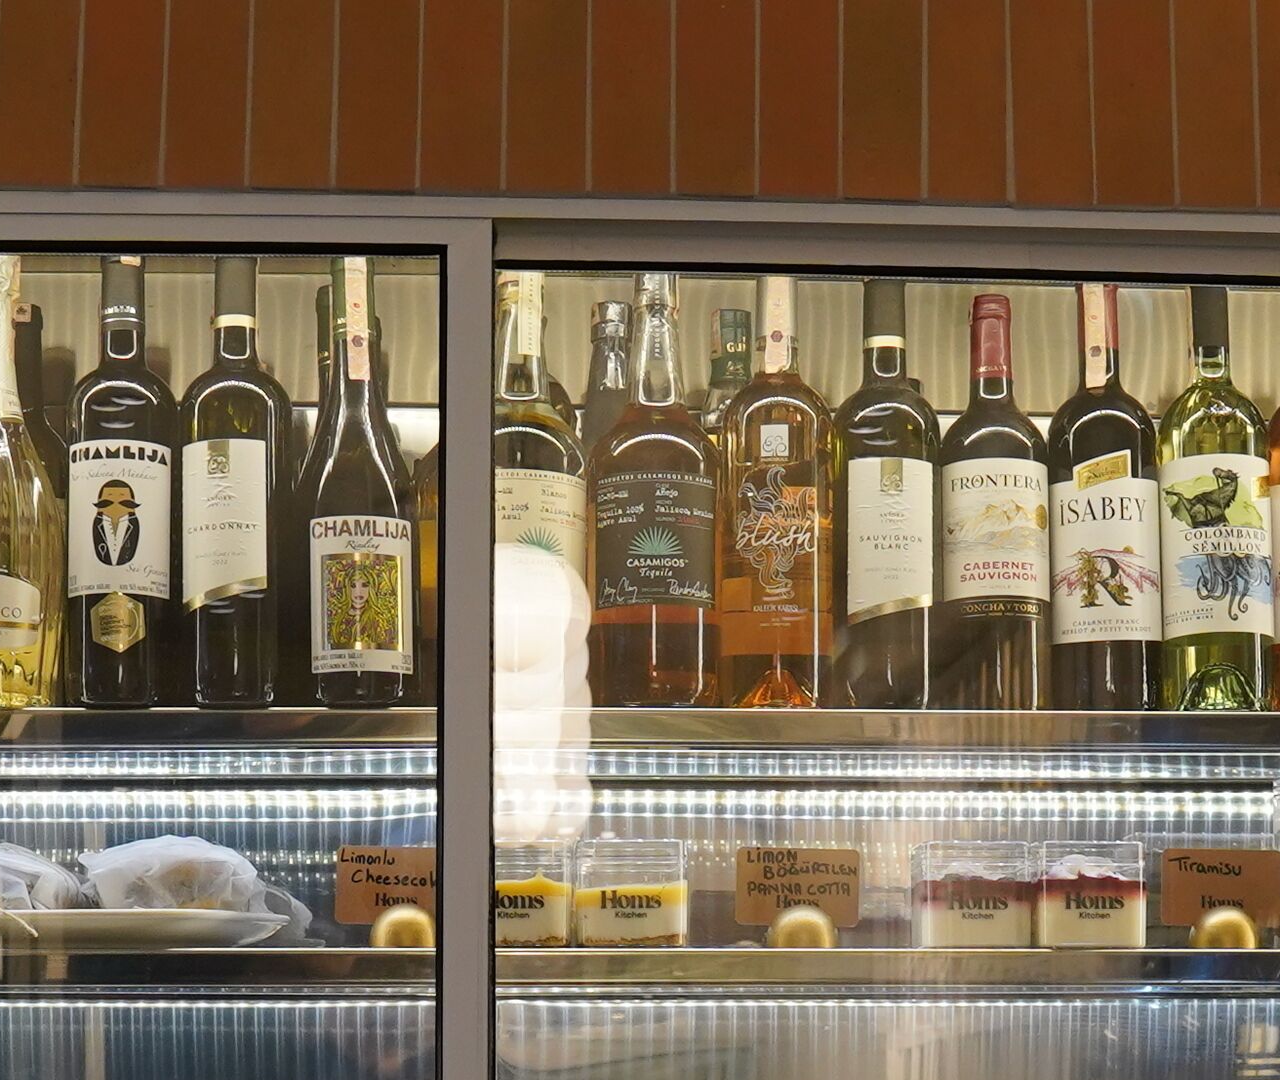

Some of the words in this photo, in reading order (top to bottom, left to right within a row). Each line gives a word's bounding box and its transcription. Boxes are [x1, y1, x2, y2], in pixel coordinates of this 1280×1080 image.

[951, 473, 1042, 493] FRONTERA
[187, 521, 258, 535] CHARDONNAY
[311, 519, 410, 542] CHAMLIJA
[736, 515, 816, 552] blush
[859, 535, 923, 544] SAUVIGNON
[1185, 527, 1267, 545] COLOMBARD
[874, 542, 910, 551] BLANC
[626, 558, 686, 569] CASAMIGOS
[963, 561, 1035, 571] CABERNET
[639, 567, 674, 579] Tequila
[960, 571, 1038, 583] SAUVIGNON
[961, 604, 1004, 614] CONCHA
[1013, 603, 1040, 614] TORO
[340, 848, 395, 866] Limonlu
[747, 881, 802, 897] PANNA
[807, 881, 851, 896] COTTA
[375, 892, 418, 906] Homs
[600, 890, 662, 909] Homs
[948, 894, 1009, 911] Homs
[1064, 891, 1125, 911] Homs
[1200, 895, 1244, 910] Homs
[497, 911, 529, 920] Kitchen
[615, 910, 648, 920] Kitchen
[961, 912, 994, 920] Kitchen
[1078, 911, 1111, 920] Kitchen
